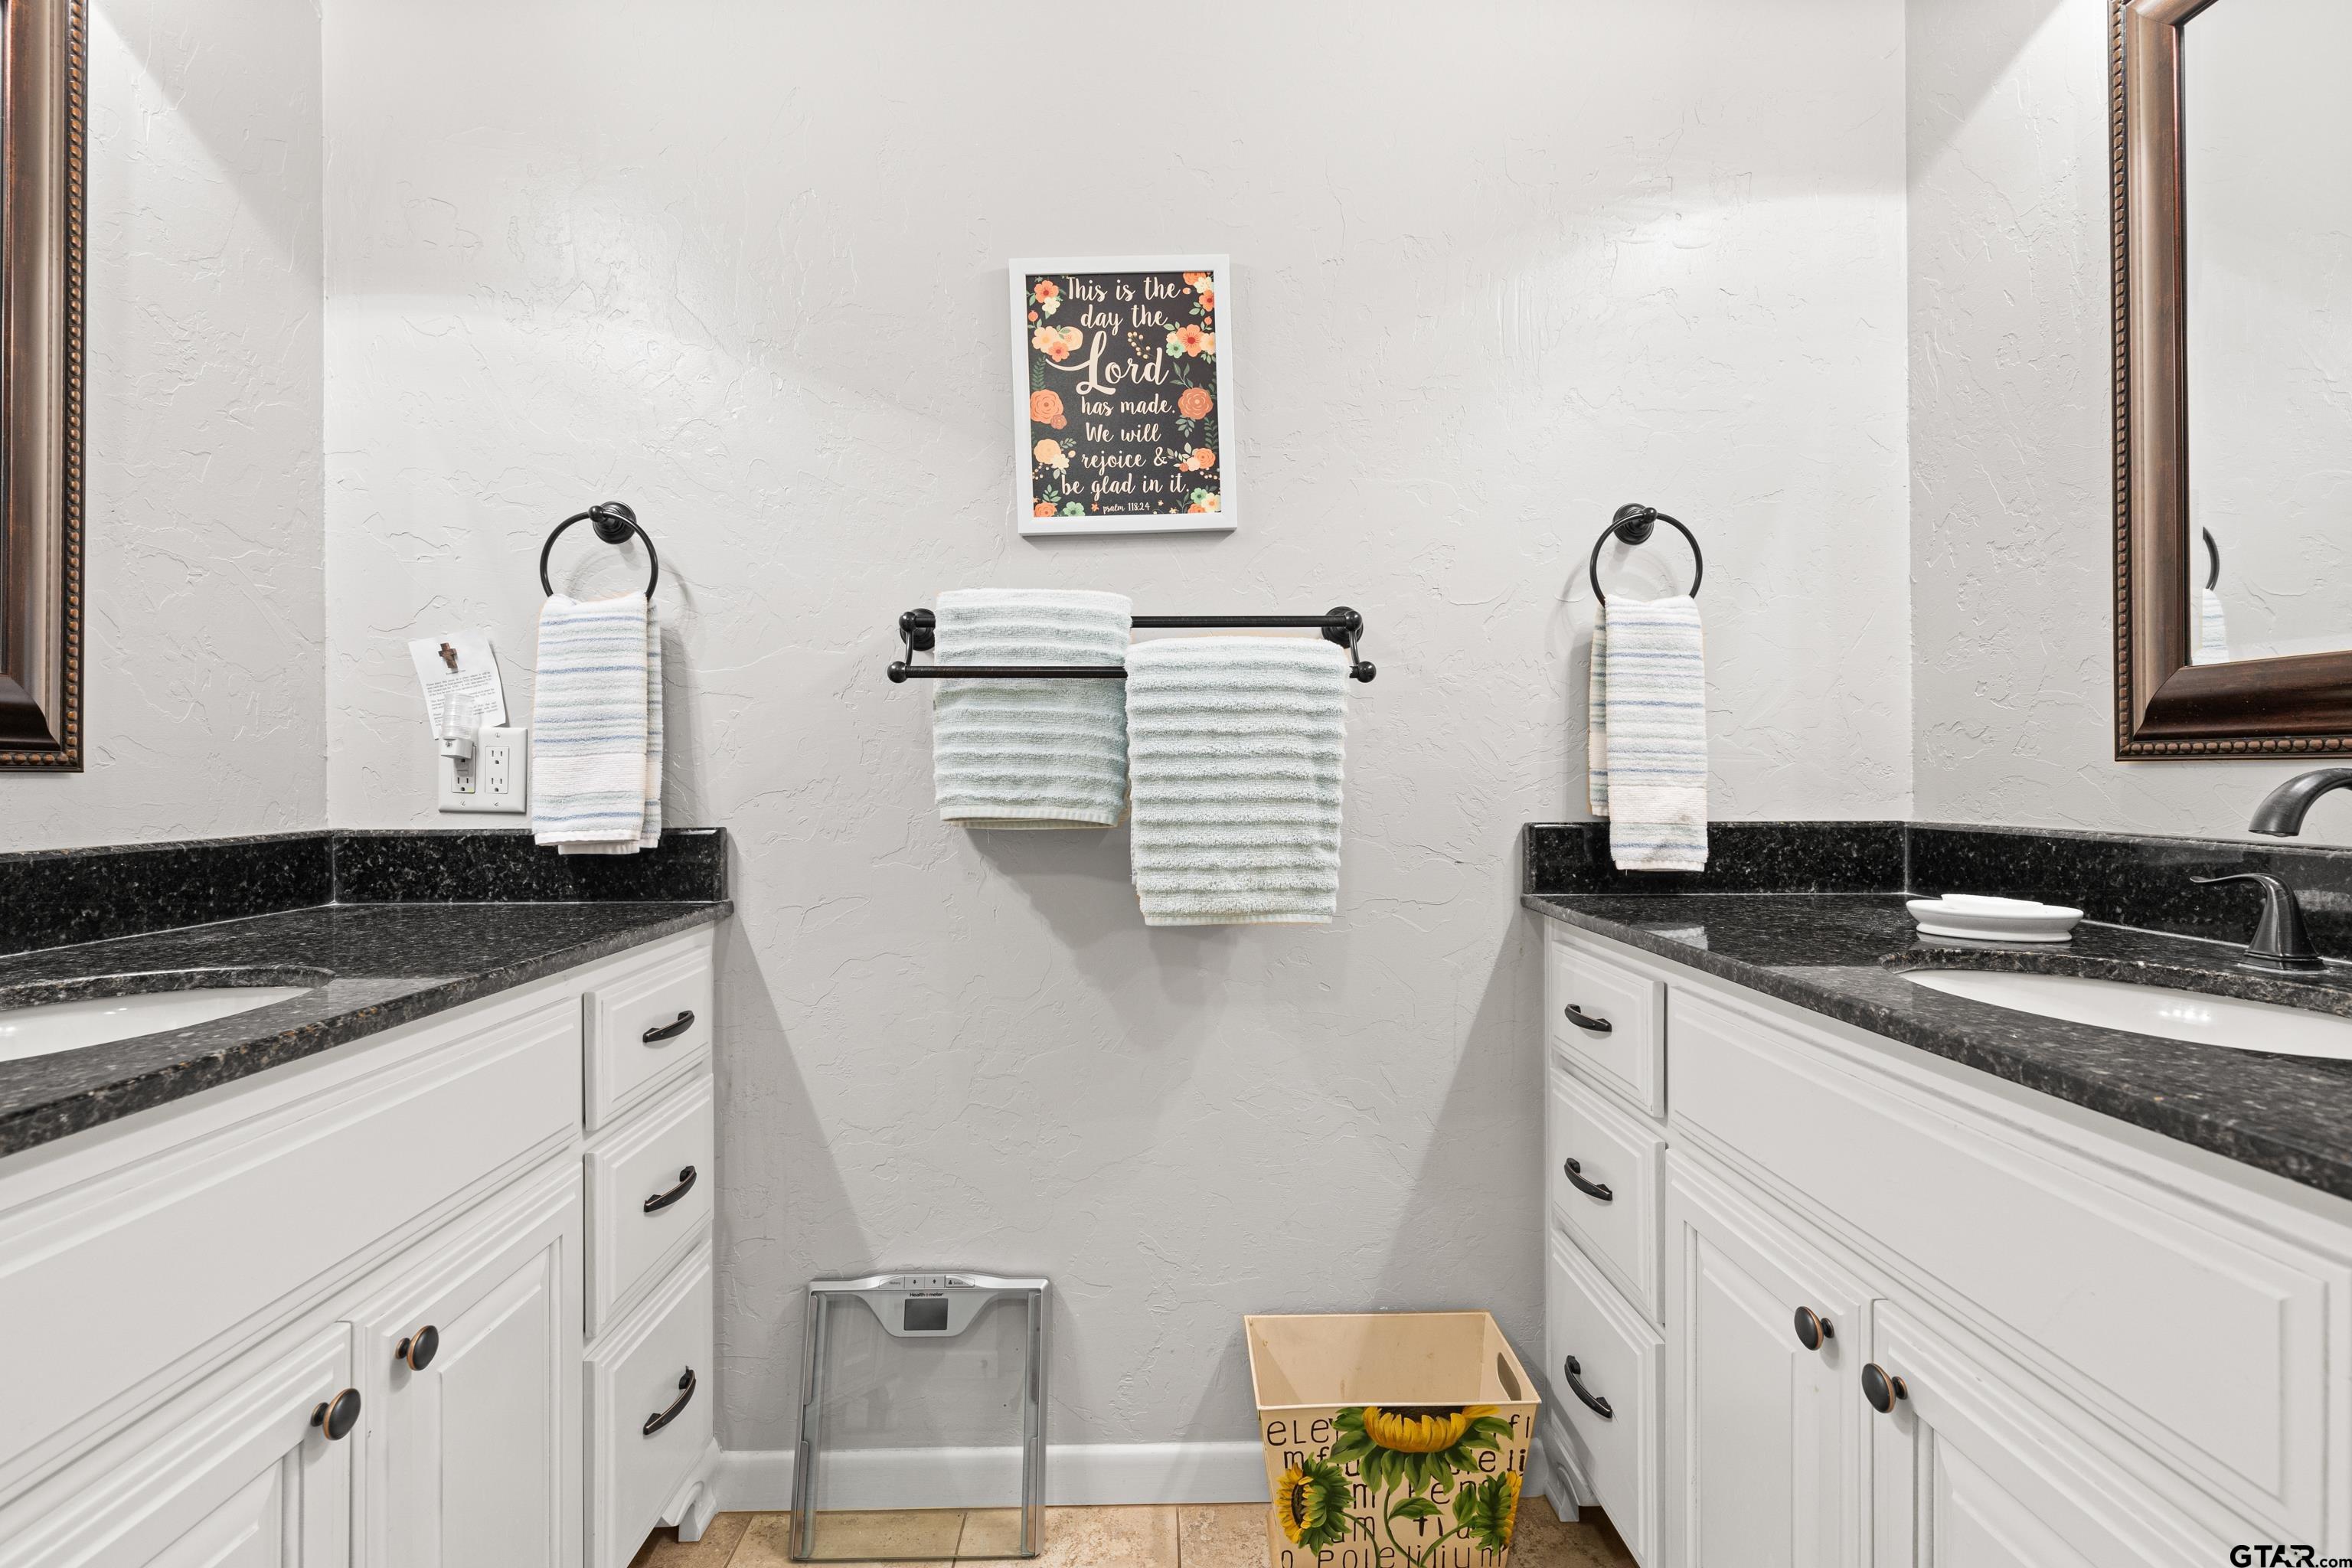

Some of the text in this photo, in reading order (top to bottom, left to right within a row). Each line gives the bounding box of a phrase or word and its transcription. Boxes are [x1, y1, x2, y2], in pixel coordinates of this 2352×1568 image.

[1067, 276, 1181, 302] This is the
[1080, 305, 1168, 335] day the
[1045, 331, 1169, 395] Lord
[1081, 394, 1175, 416] has made.
[1086, 423, 1161, 443] We will
[1082, 446, 1168, 475] rejoice &
[1061, 473, 1190, 501] be glad in it.
[1103, 502, 1125, 514] psalm
